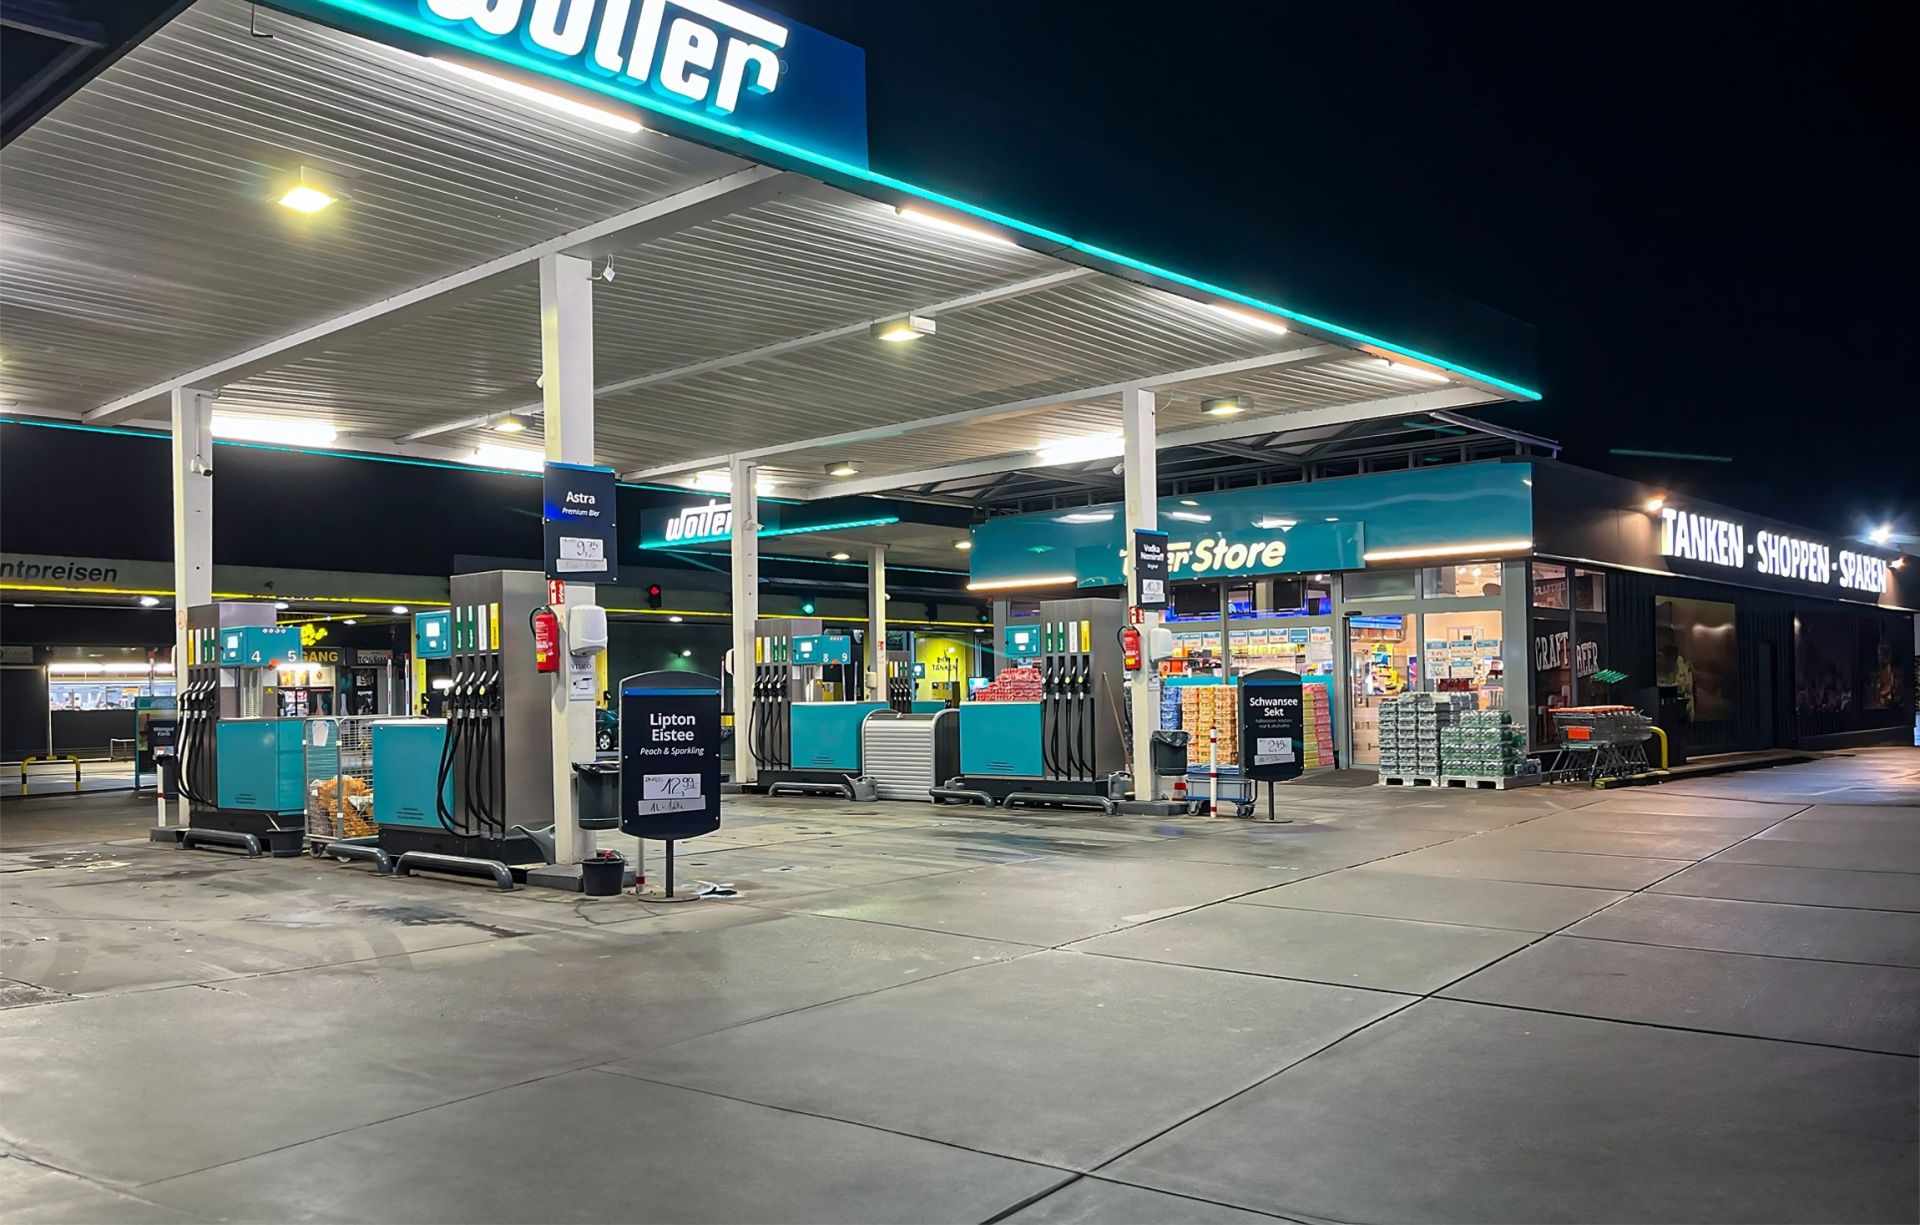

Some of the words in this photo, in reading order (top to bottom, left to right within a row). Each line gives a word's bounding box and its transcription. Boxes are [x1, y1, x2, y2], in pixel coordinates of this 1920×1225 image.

[566, 491, 596, 504] Astra
[562, 507, 588, 517] Premium
[1191, 538, 1286, 572] Store
[1661, 508, 1744, 568] TANKEN
[1757, 530, 1830, 584] SHOPPEN
[1839, 550, 1887, 593] SPAREN
[0, 560, 118, 582] ntpreisen
[251, 650, 261, 662] 4
[287, 650, 297, 662] 5
[841, 652, 849, 662] 9
[1535, 631, 1568, 671] CRAFT
[823, 653, 830, 662] 8
[1576, 641, 1600, 678] BEER
[1249, 697, 1298, 706] Schwansee
[1264, 707, 1284, 716] Sekt
[650, 713, 696, 729] Lipton
[651, 728, 695, 741] Eistee
[640, 747, 662, 755] Peach
[670, 747, 704, 756] Sparkling
